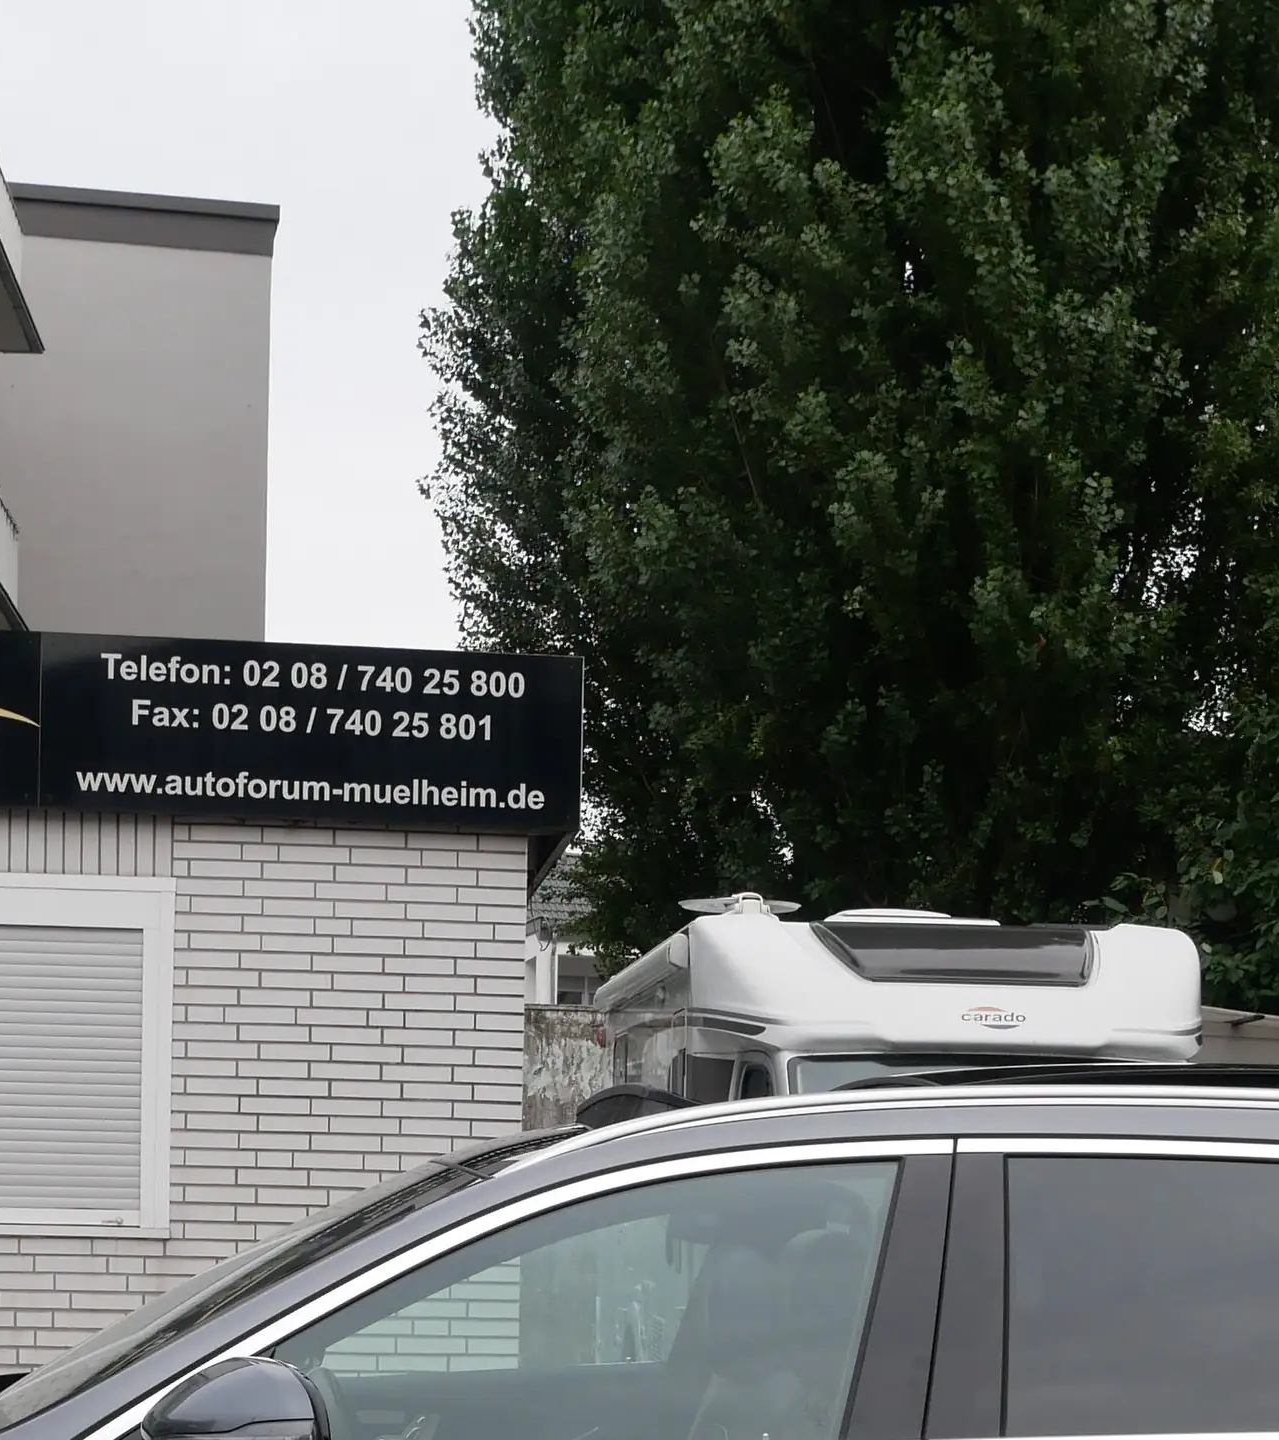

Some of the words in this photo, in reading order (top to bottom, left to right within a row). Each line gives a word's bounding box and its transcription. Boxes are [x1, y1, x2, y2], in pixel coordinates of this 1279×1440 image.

[100, 652, 231, 685] Telefon:
[243, 659, 280, 688] 02
[290, 662, 328, 690] 08
[336, 663, 348, 691] /
[357, 665, 413, 694] 740
[422, 668, 460, 696] 25
[470, 670, 525, 698] 800
[131, 699, 200, 728] Fax:
[212, 702, 249, 731] 02
[259, 705, 297, 733] 08
[305, 706, 317, 734] /
[326, 708, 382, 737] 740
[391, 711, 430, 739] 25
[439, 713, 491, 741] 801
[76, 771, 545, 810] www.autoforum-muelheim.de
[961, 1012, 1026, 1022] carado
